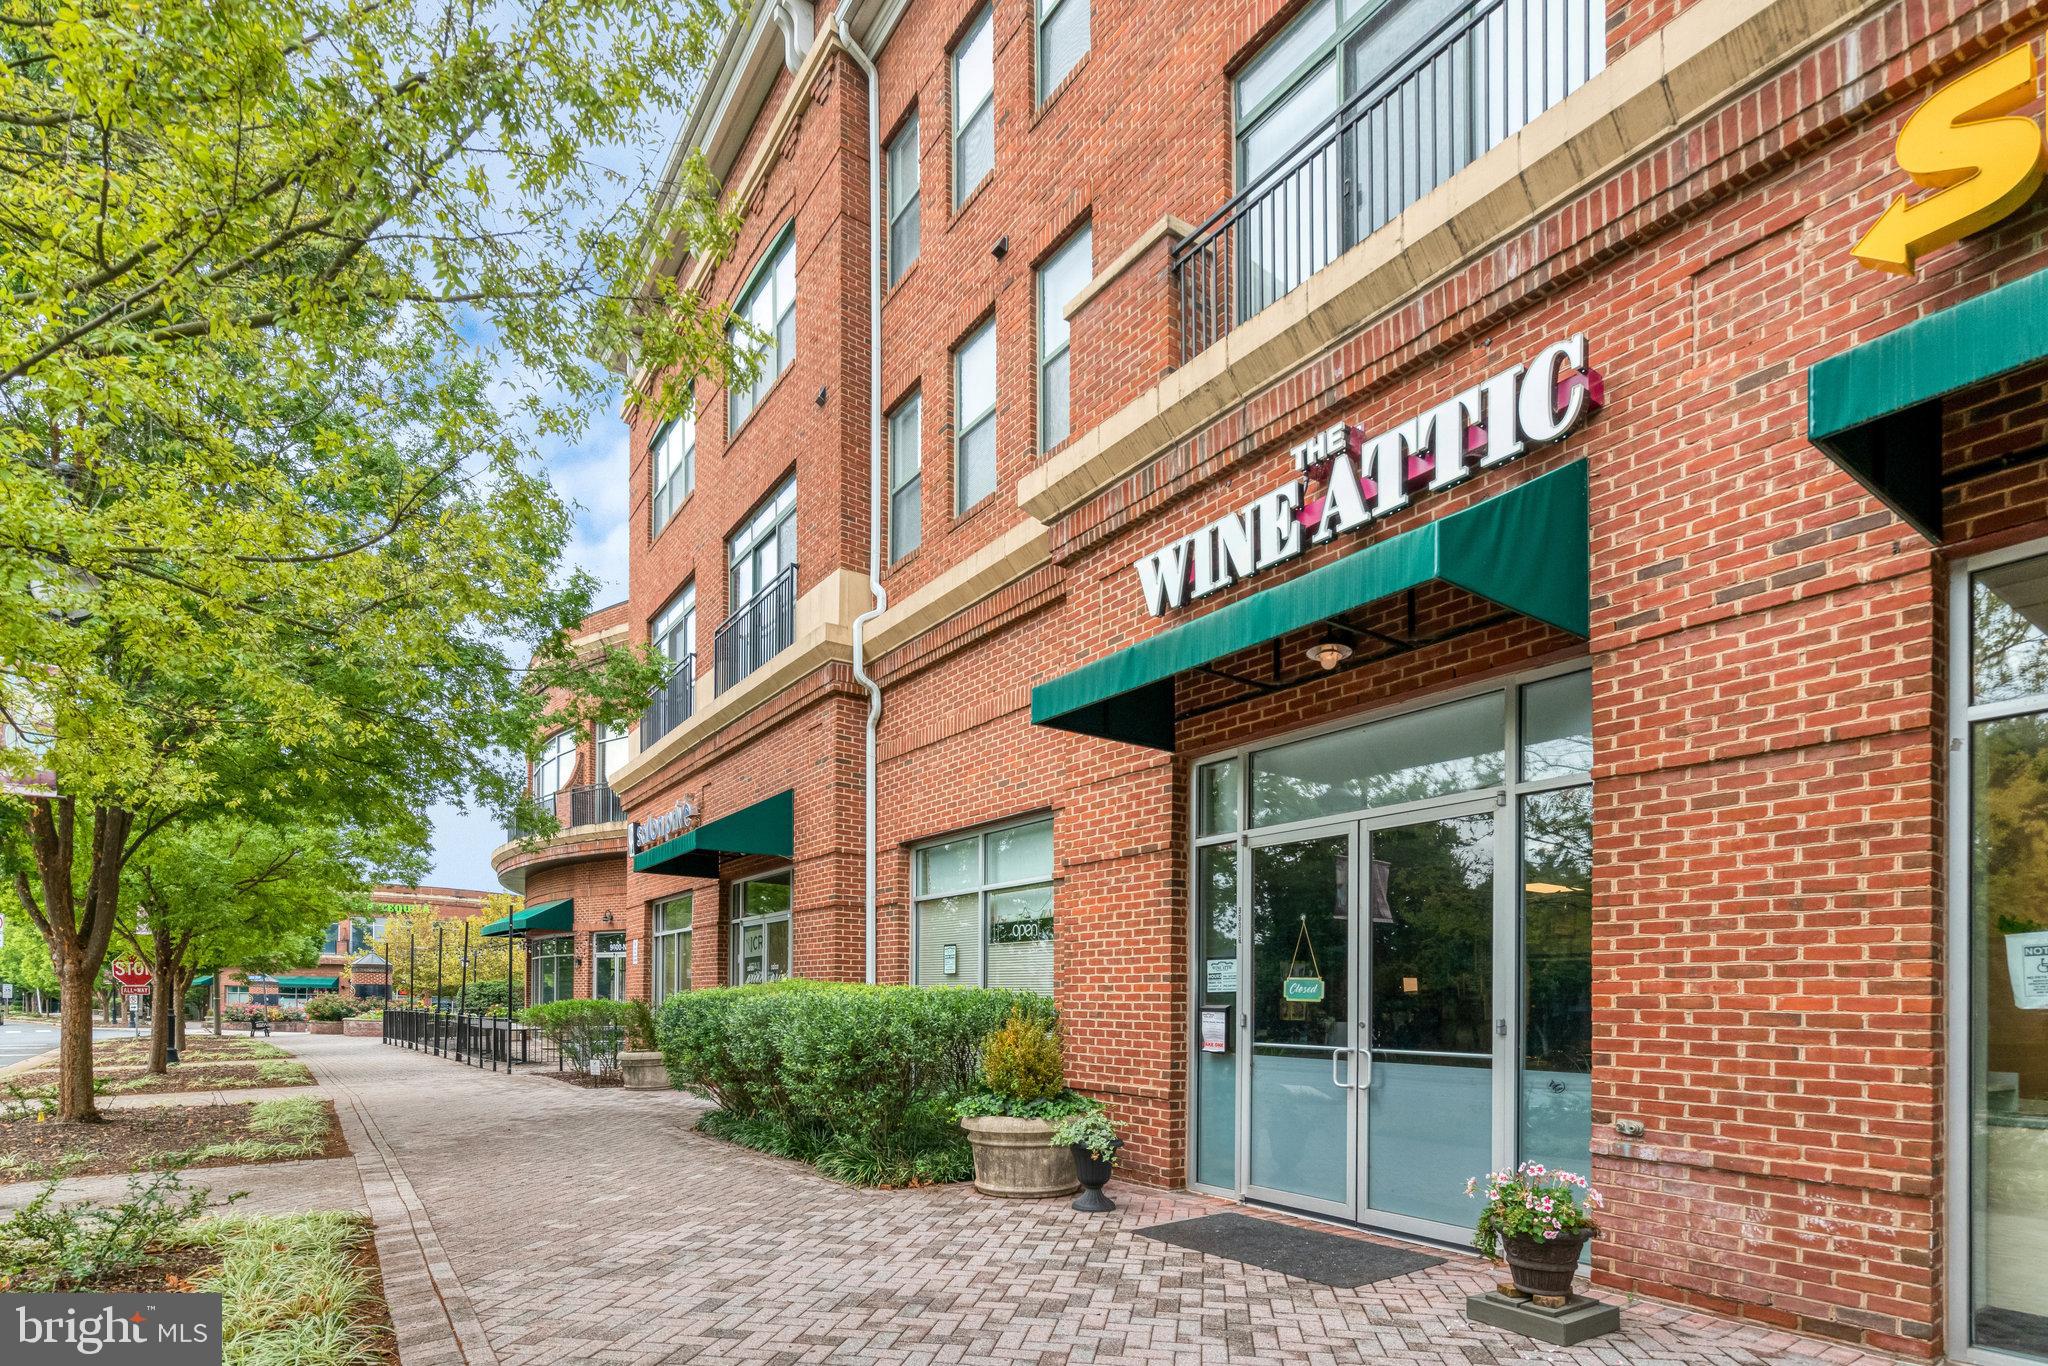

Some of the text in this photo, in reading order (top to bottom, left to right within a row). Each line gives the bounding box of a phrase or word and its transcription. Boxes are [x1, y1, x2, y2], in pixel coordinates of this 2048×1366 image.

[1290, 420, 1349, 471] THE
[1133, 332, 1588, 617] WINE ATTIC
[1012, 923, 1038, 940] open
[1290, 983, 1318, 995] Closed
